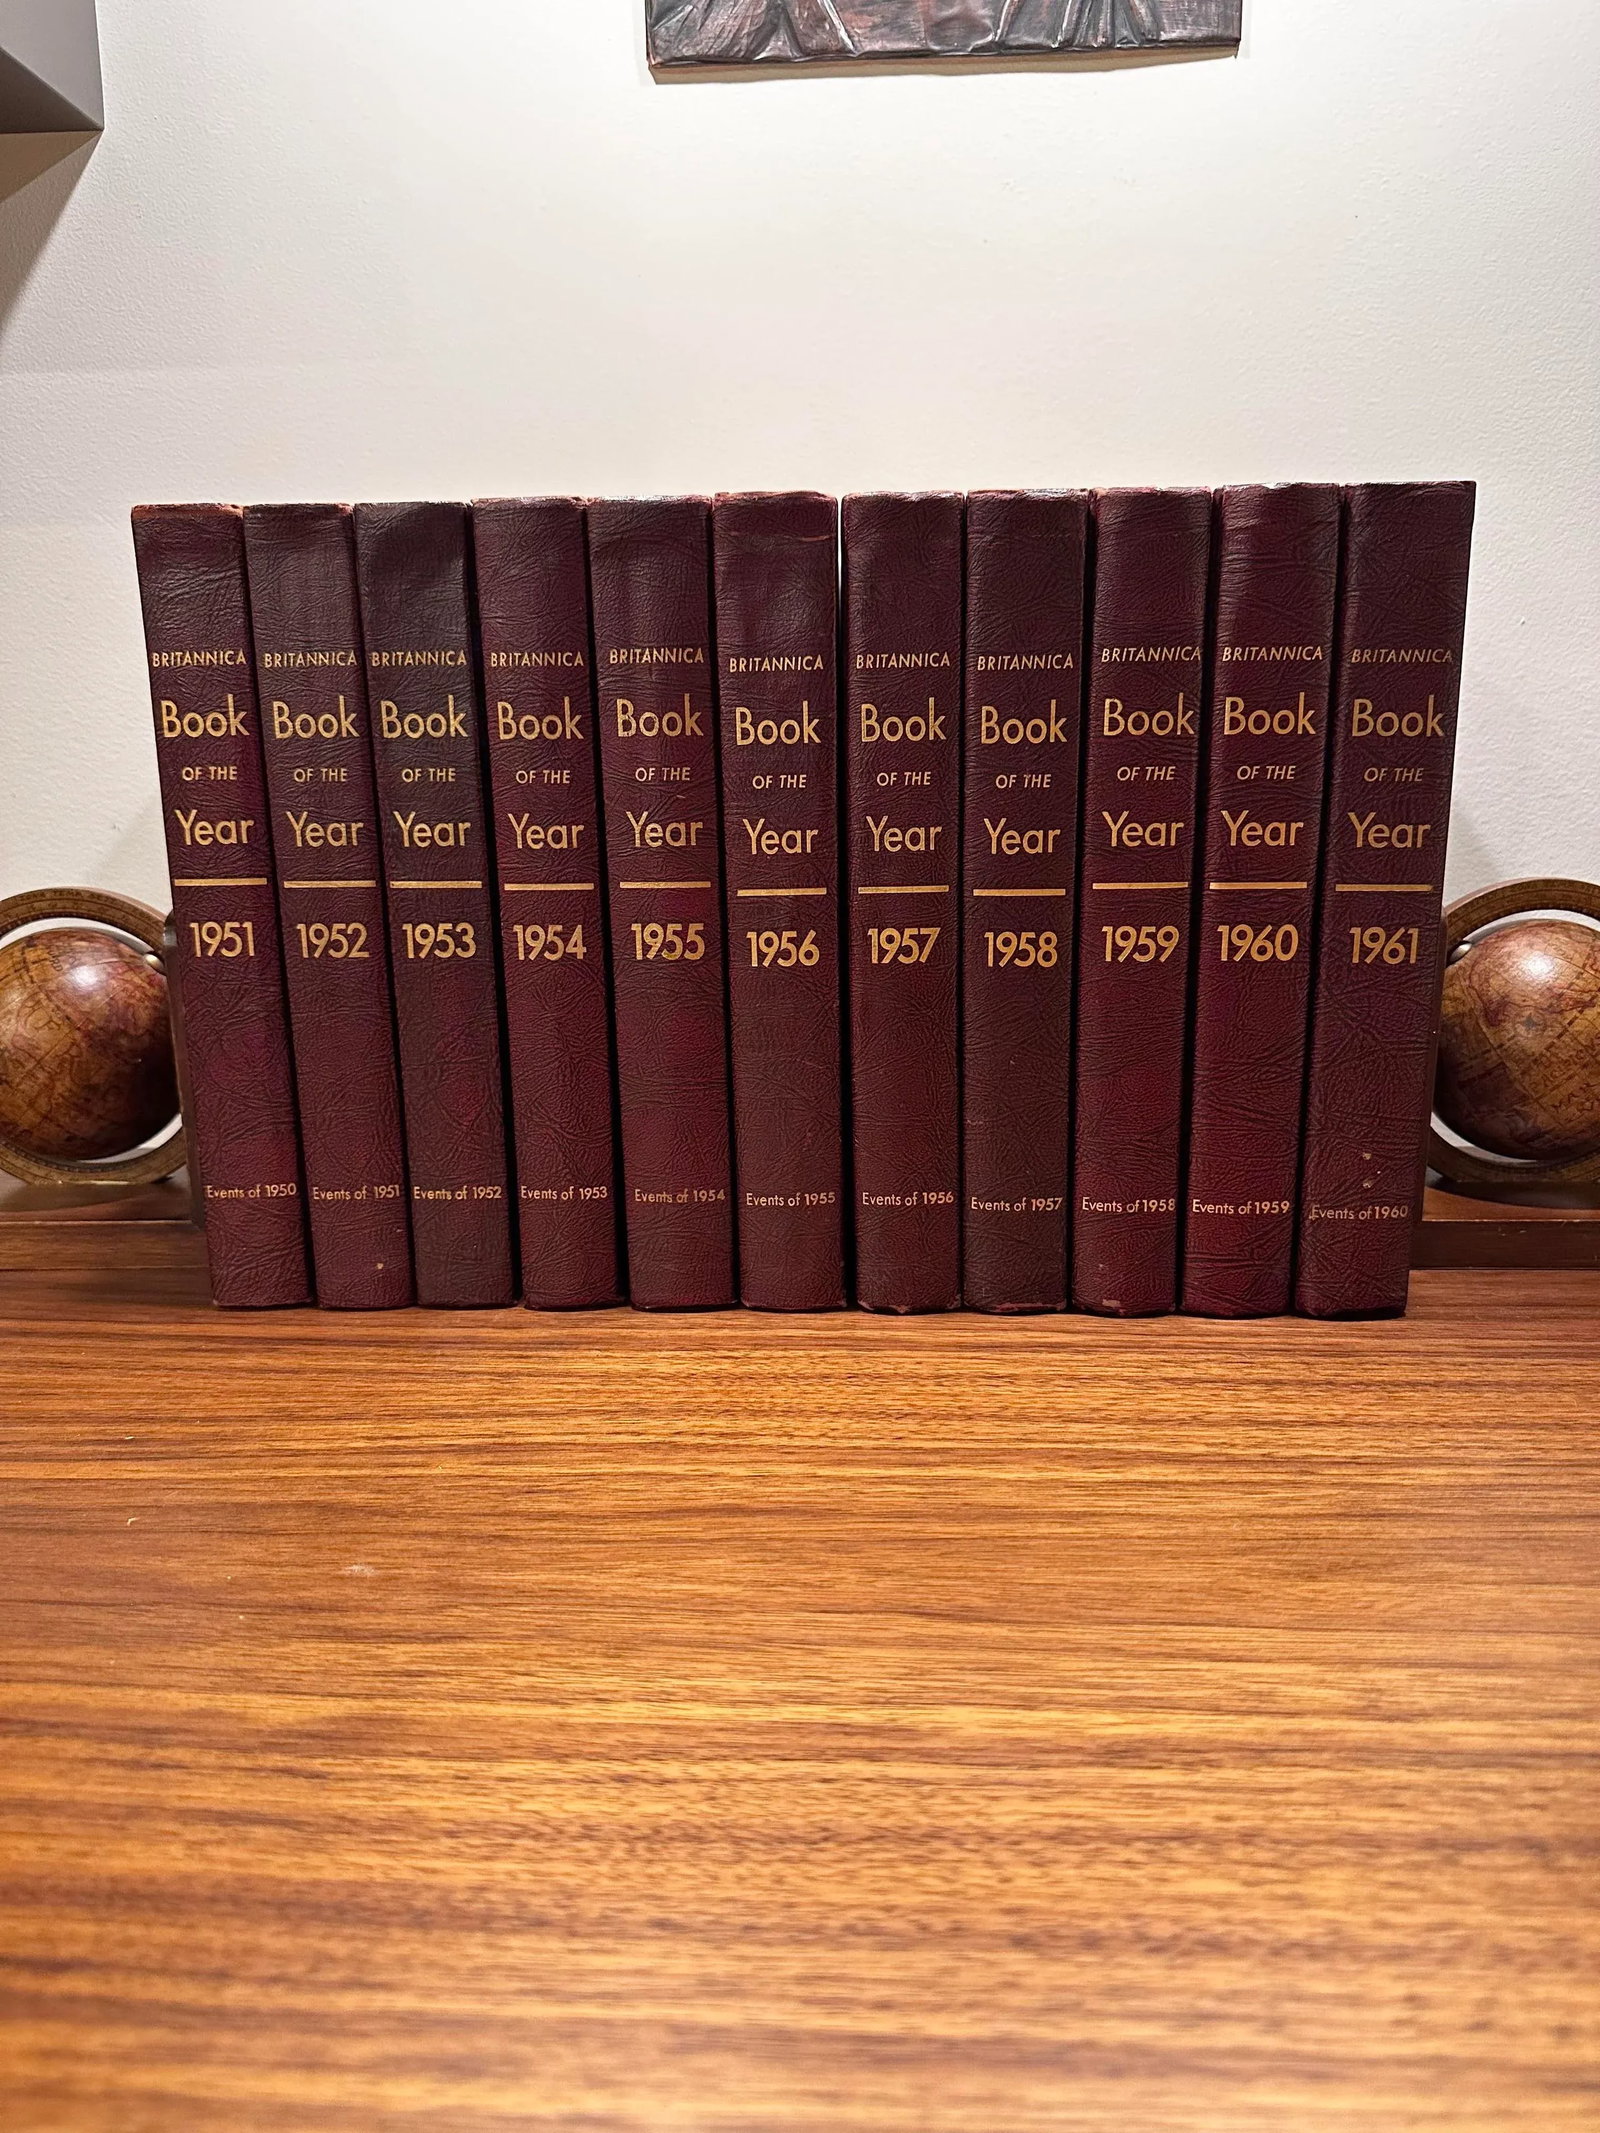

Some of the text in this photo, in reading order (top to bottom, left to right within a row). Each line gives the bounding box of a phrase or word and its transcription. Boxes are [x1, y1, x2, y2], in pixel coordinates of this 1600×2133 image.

[153, 649, 246, 667] BRITANNICA
[265, 650, 356, 668] BRITANNICA
[372, 650, 466, 666] BRITANNICA
[491, 652, 583, 667] BRITANNICA
[610, 648, 703, 664] BRITANNICA
[730, 655, 823, 672] BRITANNICA
[857, 652, 949, 669] BRITANNICA
[978, 653, 1073, 670] BRITANNICA
[1101, 646, 1200, 662] BRITANNICA
[1222, 646, 1322, 661] BRITANNICA
[1351, 648, 1453, 664] BRITANNICA
[161, 694, 249, 737] Book
[273, 695, 359, 738] Book
[381, 695, 468, 738] Book
[498, 697, 583, 740] Book
[617, 694, 703, 737] Book
[736, 701, 821, 745] Book
[861, 697, 946, 742] Book
[981, 699, 1067, 744] Book
[1104, 693, 1194, 735] Book
[1224, 692, 1316, 735] Book
[1352, 695, 1444, 736] Book
[182, 766, 237, 781] OF THE
[294, 768, 347, 782] OF THE
[402, 768, 456, 782] OF THE
[516, 770, 570, 783] OF THE
[636, 767, 690, 781] OF THE
[753, 775, 806, 789] OF THE
[877, 772, 931, 786] OF THE
[996, 774, 1051, 788] OF THE
[1117, 766, 1175, 781] OF THE
[1237, 766, 1296, 780] OF THE
[1364, 768, 1424, 781] OF THE
[175, 809, 254, 845] Year
[286, 811, 363, 847] Year
[393, 811, 471, 847] Year
[508, 813, 584, 849] Year
[626, 811, 702, 847] Year
[743, 818, 818, 854] Year
[866, 816, 942, 852] Year
[984, 818, 1060, 854] Year
[1102, 811, 1184, 847] Year
[1221, 810, 1304, 846] Year
[1348, 812, 1431, 848] Year
[190, 922, 254, 957] 1951
[296, 923, 369, 958] 1952
[402, 923, 476, 958] 1953
[513, 925, 586, 960] 1954
[631, 923, 705, 960] 1955
[746, 930, 819, 967] 1956
[867, 928, 941, 964] 1957
[984, 932, 1057, 967] 1958
[1102, 926, 1179, 962] 1959
[1217, 924, 1298, 961] 1960
[1350, 927, 1418, 964] 1961
[206, 1183, 296, 1198] Events of 1950
[313, 1185, 399, 1200] Events of 1951
[414, 1185, 501, 1200] Events of 1952
[521, 1186, 607, 1200] Events of 1953
[635, 1188, 725, 1203] Events of 1954
[747, 1192, 835, 1206] Events of 1955
[863, 1192, 953, 1206] Events of 1956
[972, 1197, 1062, 1211] Events of 1957
[1083, 1197, 1175, 1212] Events of 1958
[1193, 1199, 1289, 1214] Events of 1959
[1309, 1204, 1408, 1220] Events of 1960
